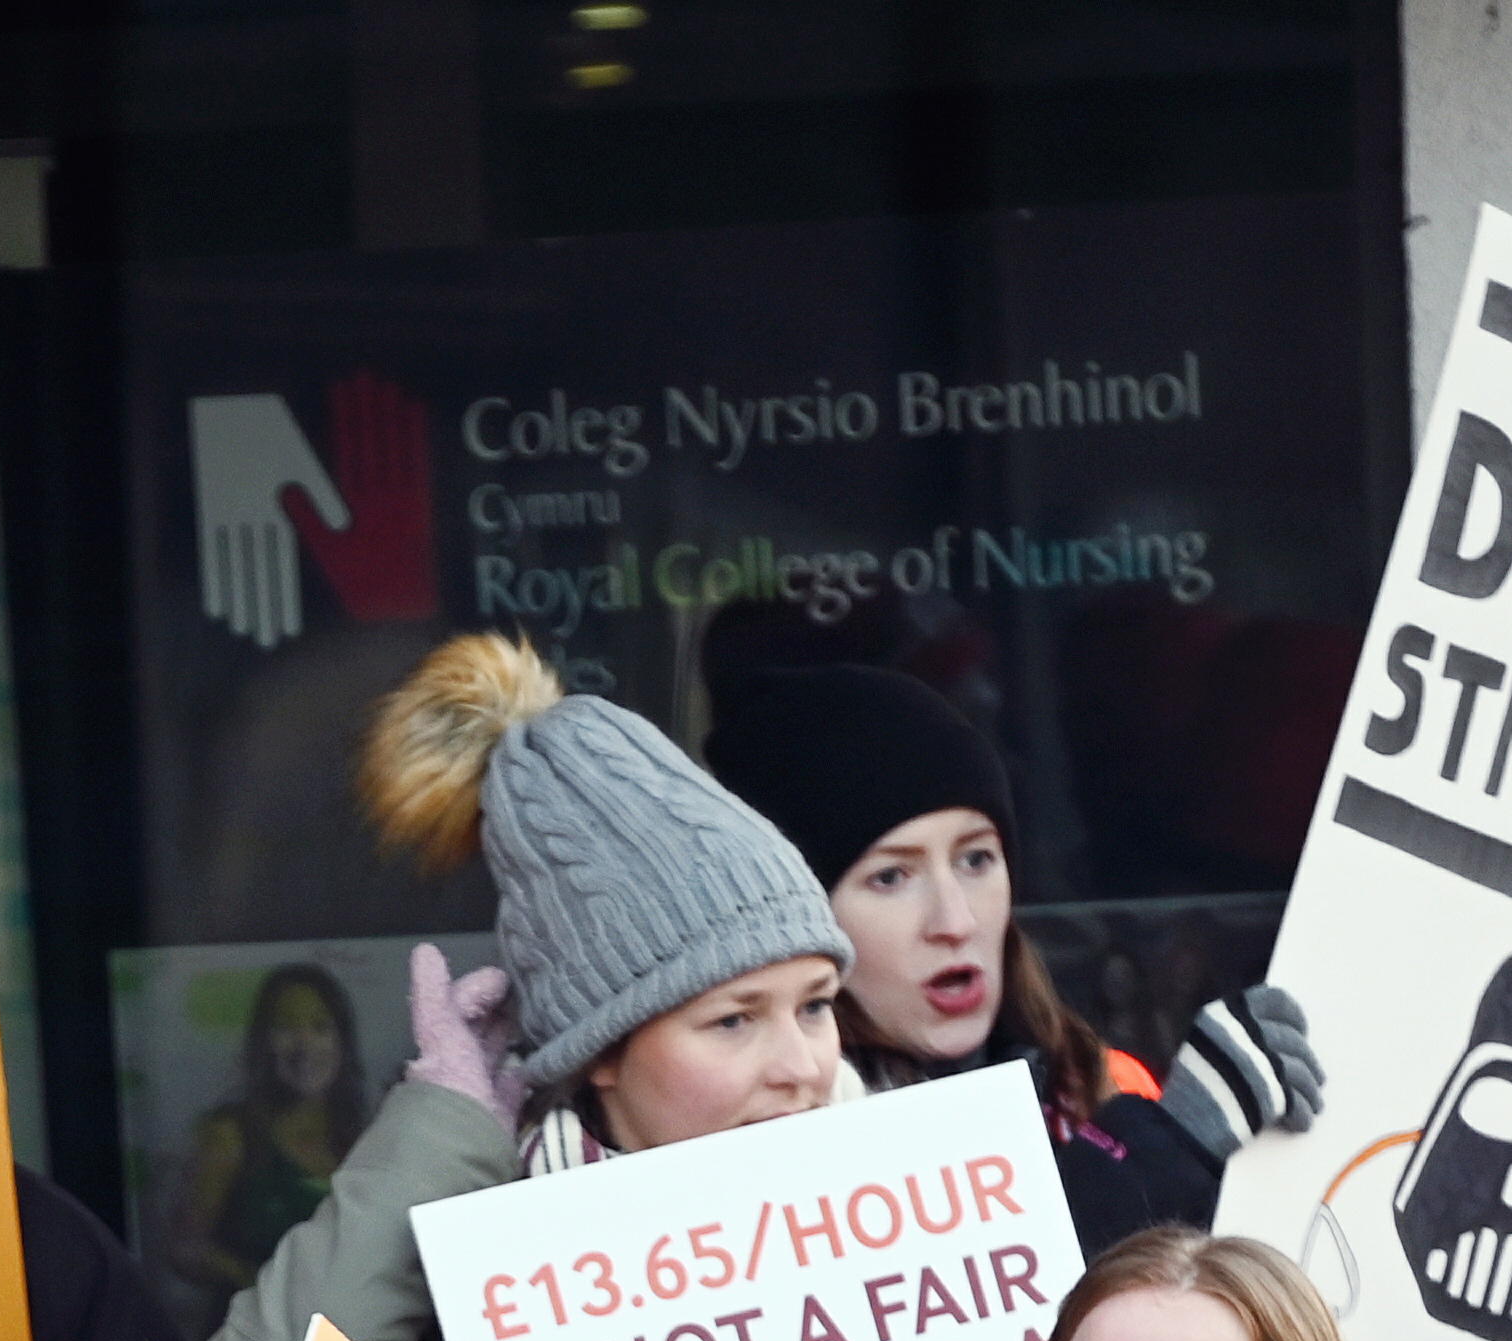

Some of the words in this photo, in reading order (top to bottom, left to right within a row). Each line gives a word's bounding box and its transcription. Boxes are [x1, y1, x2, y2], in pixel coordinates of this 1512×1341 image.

[463, 395, 649, 477] Coleg
[664, 378, 877, 471] Nyrsio
[896, 351, 1203, 436] Brenhinol
[468, 483, 622, 536] Cymru
[476, 545, 641, 635] Royal
[654, 540, 878, 624] College
[891, 527, 960, 596] of
[971, 521, 1215, 603] Nursing
[482, 1154, 1025, 1341] £13.65/HOUR
